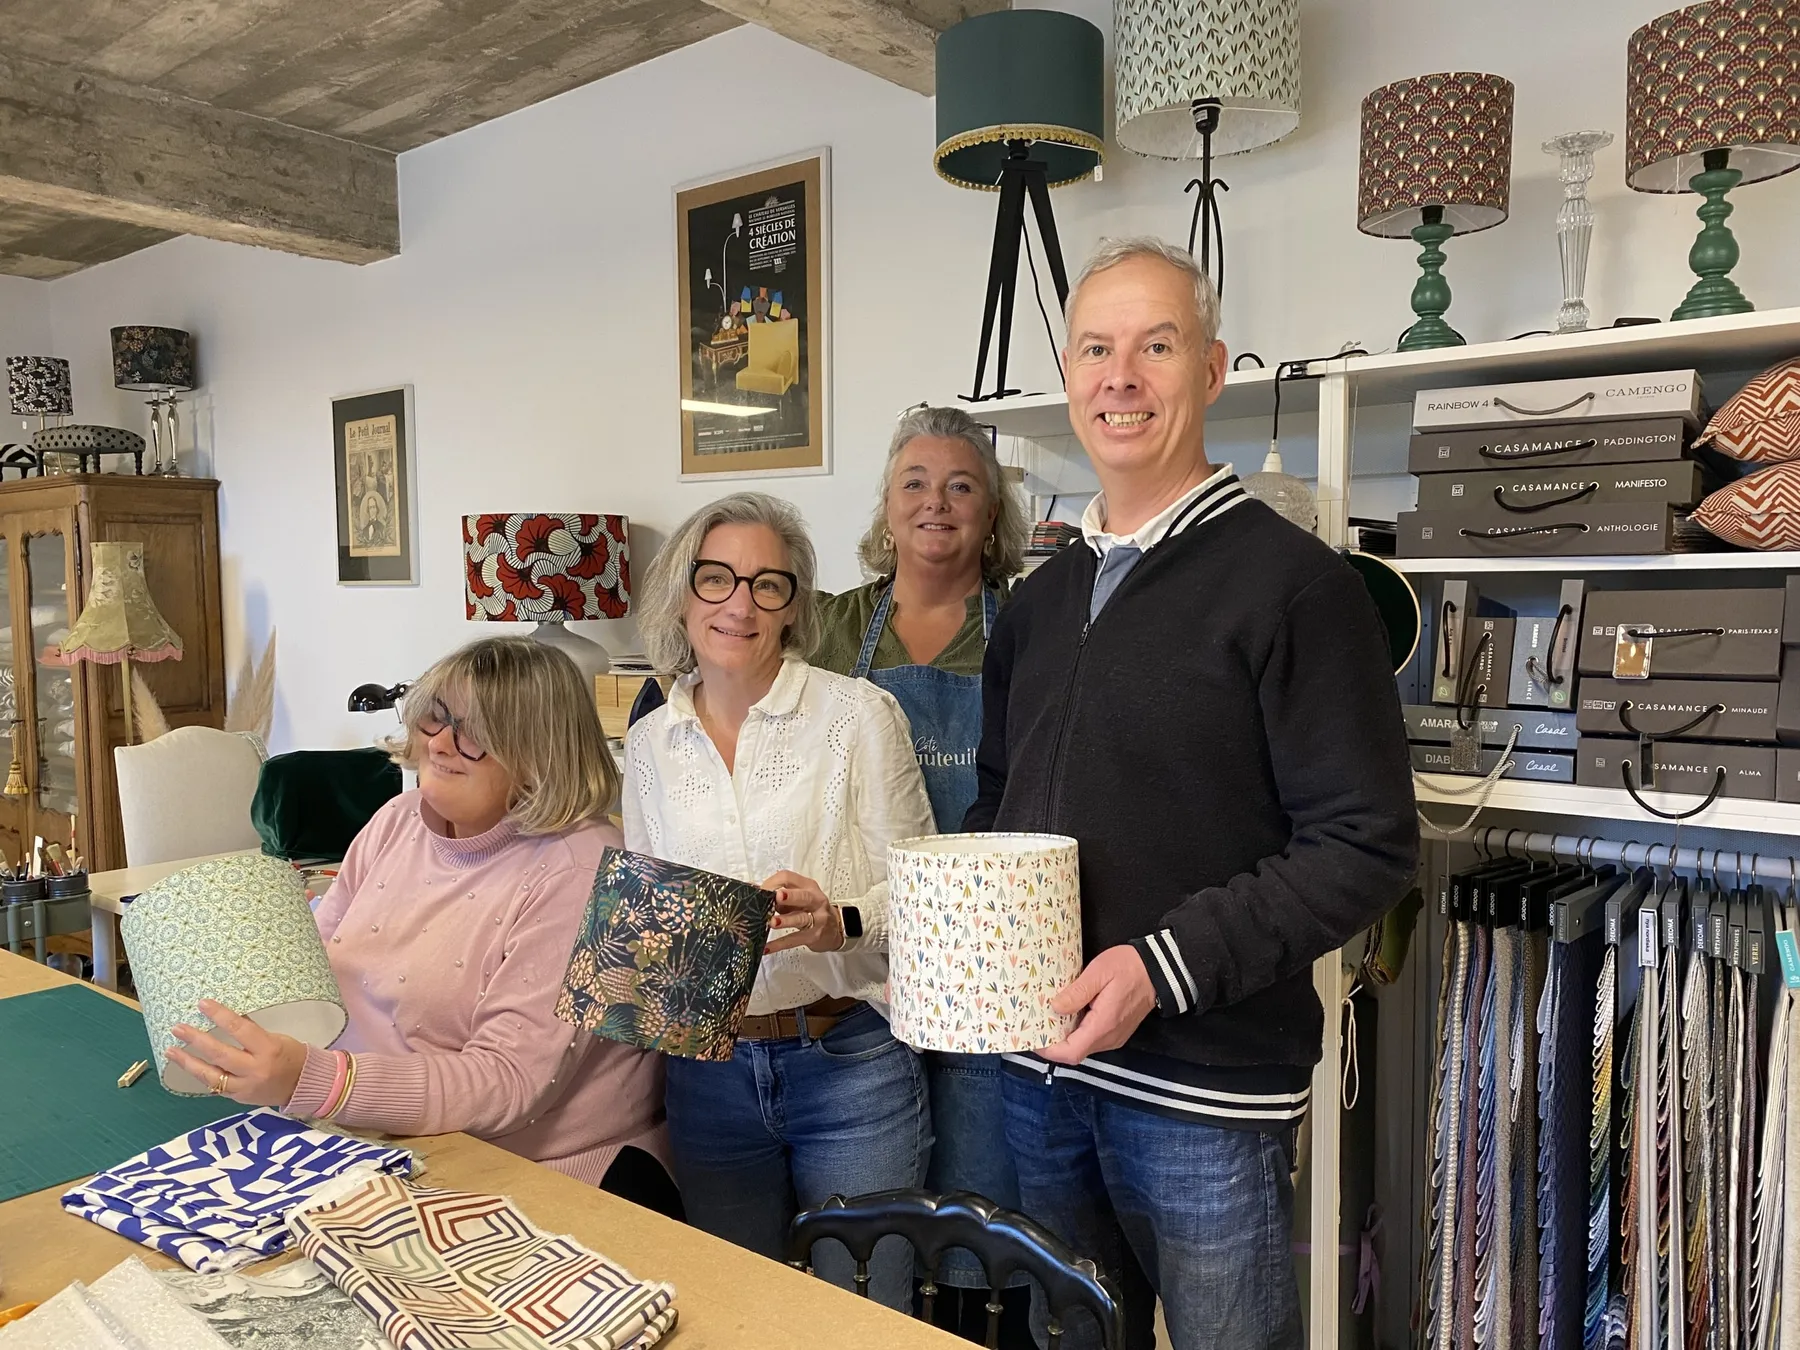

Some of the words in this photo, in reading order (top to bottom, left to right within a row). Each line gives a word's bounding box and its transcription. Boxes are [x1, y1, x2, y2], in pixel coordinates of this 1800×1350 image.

[748, 228, 754, 236] 4
[755, 221, 783, 235] SIÈCLES
[785, 218, 795, 229] DE
[749, 229, 796, 249] CRÉATION
[1605, 383, 1687, 398] CAMENGO
[1427, 400, 1480, 411] RAINBOW
[1482, 400, 1490, 408] 4
[1604, 434, 1676, 446] PADDINGTON
[1512, 482, 1585, 492] CASAMANCE
[1614, 478, 1667, 489] MANIFESTO
[1596, 523, 1659, 532] ANTHOLOGIE
[1486, 642, 1494, 680] CASAMANCE
[1638, 703, 1708, 713] CASAMANCE
[1731, 706, 1768, 714] MINAUDE
[1420, 718, 1460, 729] AMARA
[916, 748, 976, 767] auteuil
[1425, 753, 1450, 764] DIAB
[1654, 762, 1709, 774] SAMANCE
[1739, 769, 1761, 777] ALMA
